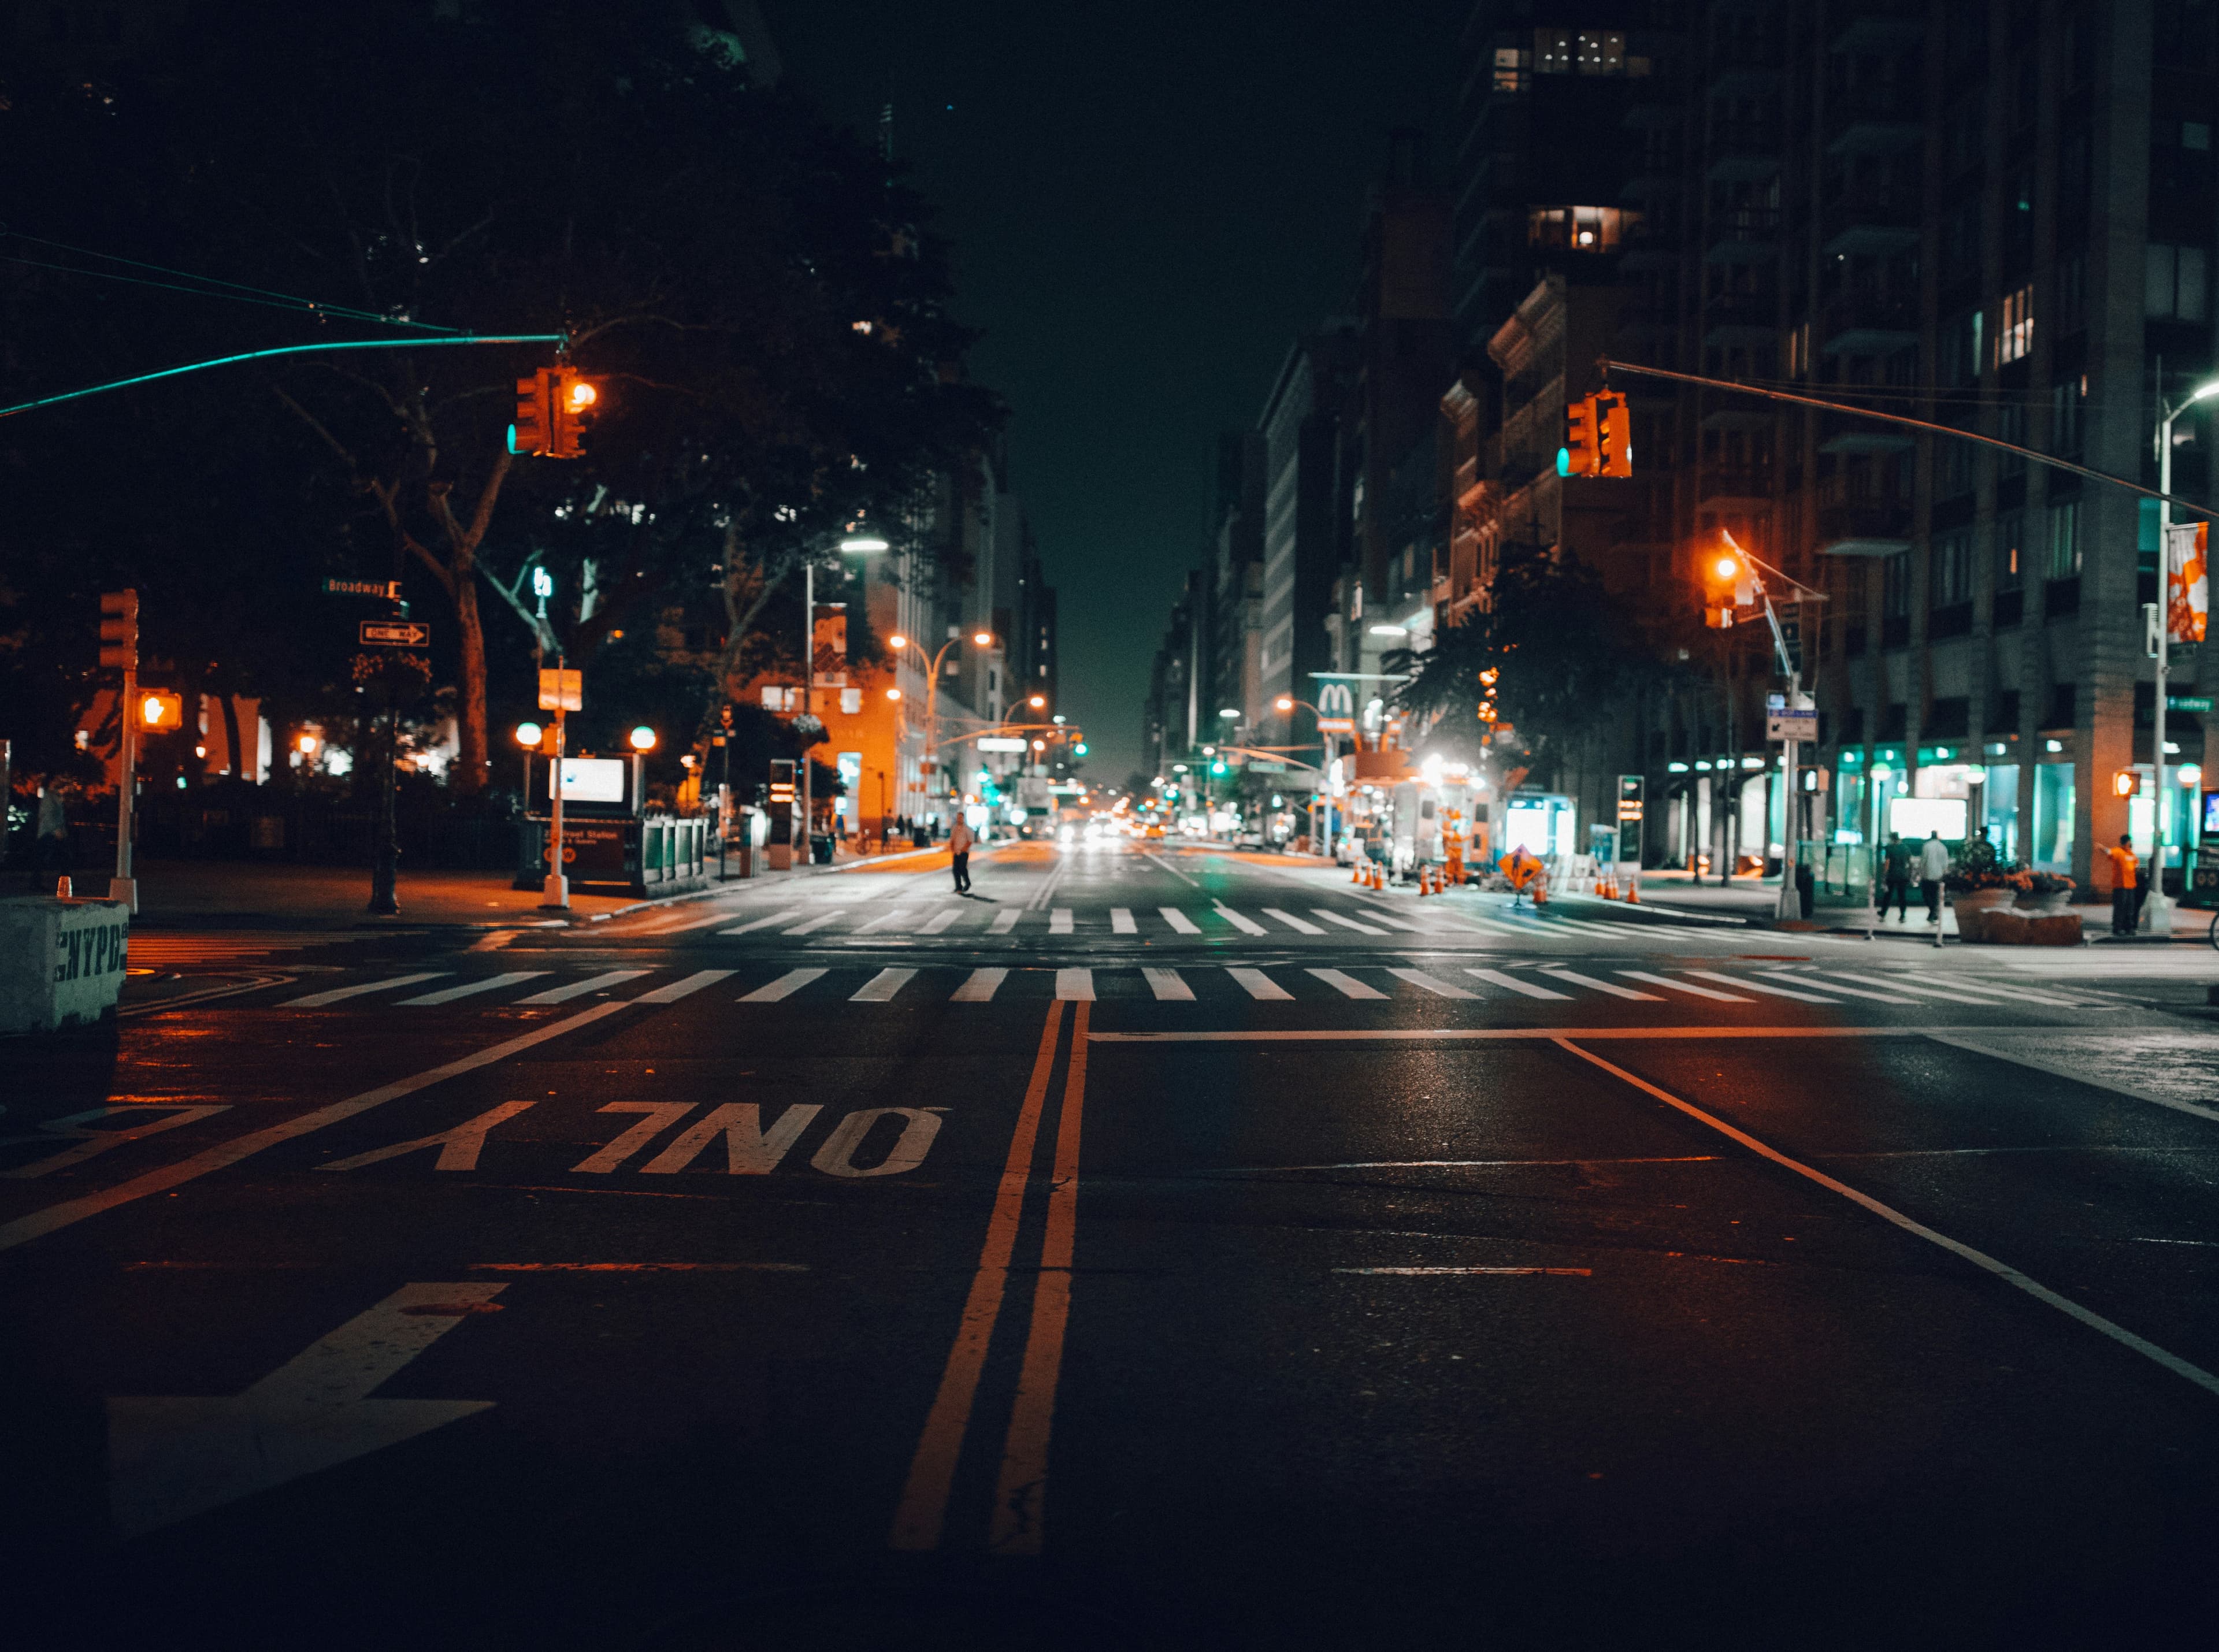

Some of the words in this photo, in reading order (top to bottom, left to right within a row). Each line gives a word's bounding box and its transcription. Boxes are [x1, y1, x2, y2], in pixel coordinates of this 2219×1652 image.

[329, 579, 384, 597] Broadway
[371, 629, 389, 637] ONE
[66, 924, 120, 980] NYPD
[311, 1100, 949, 1178] ONLY
